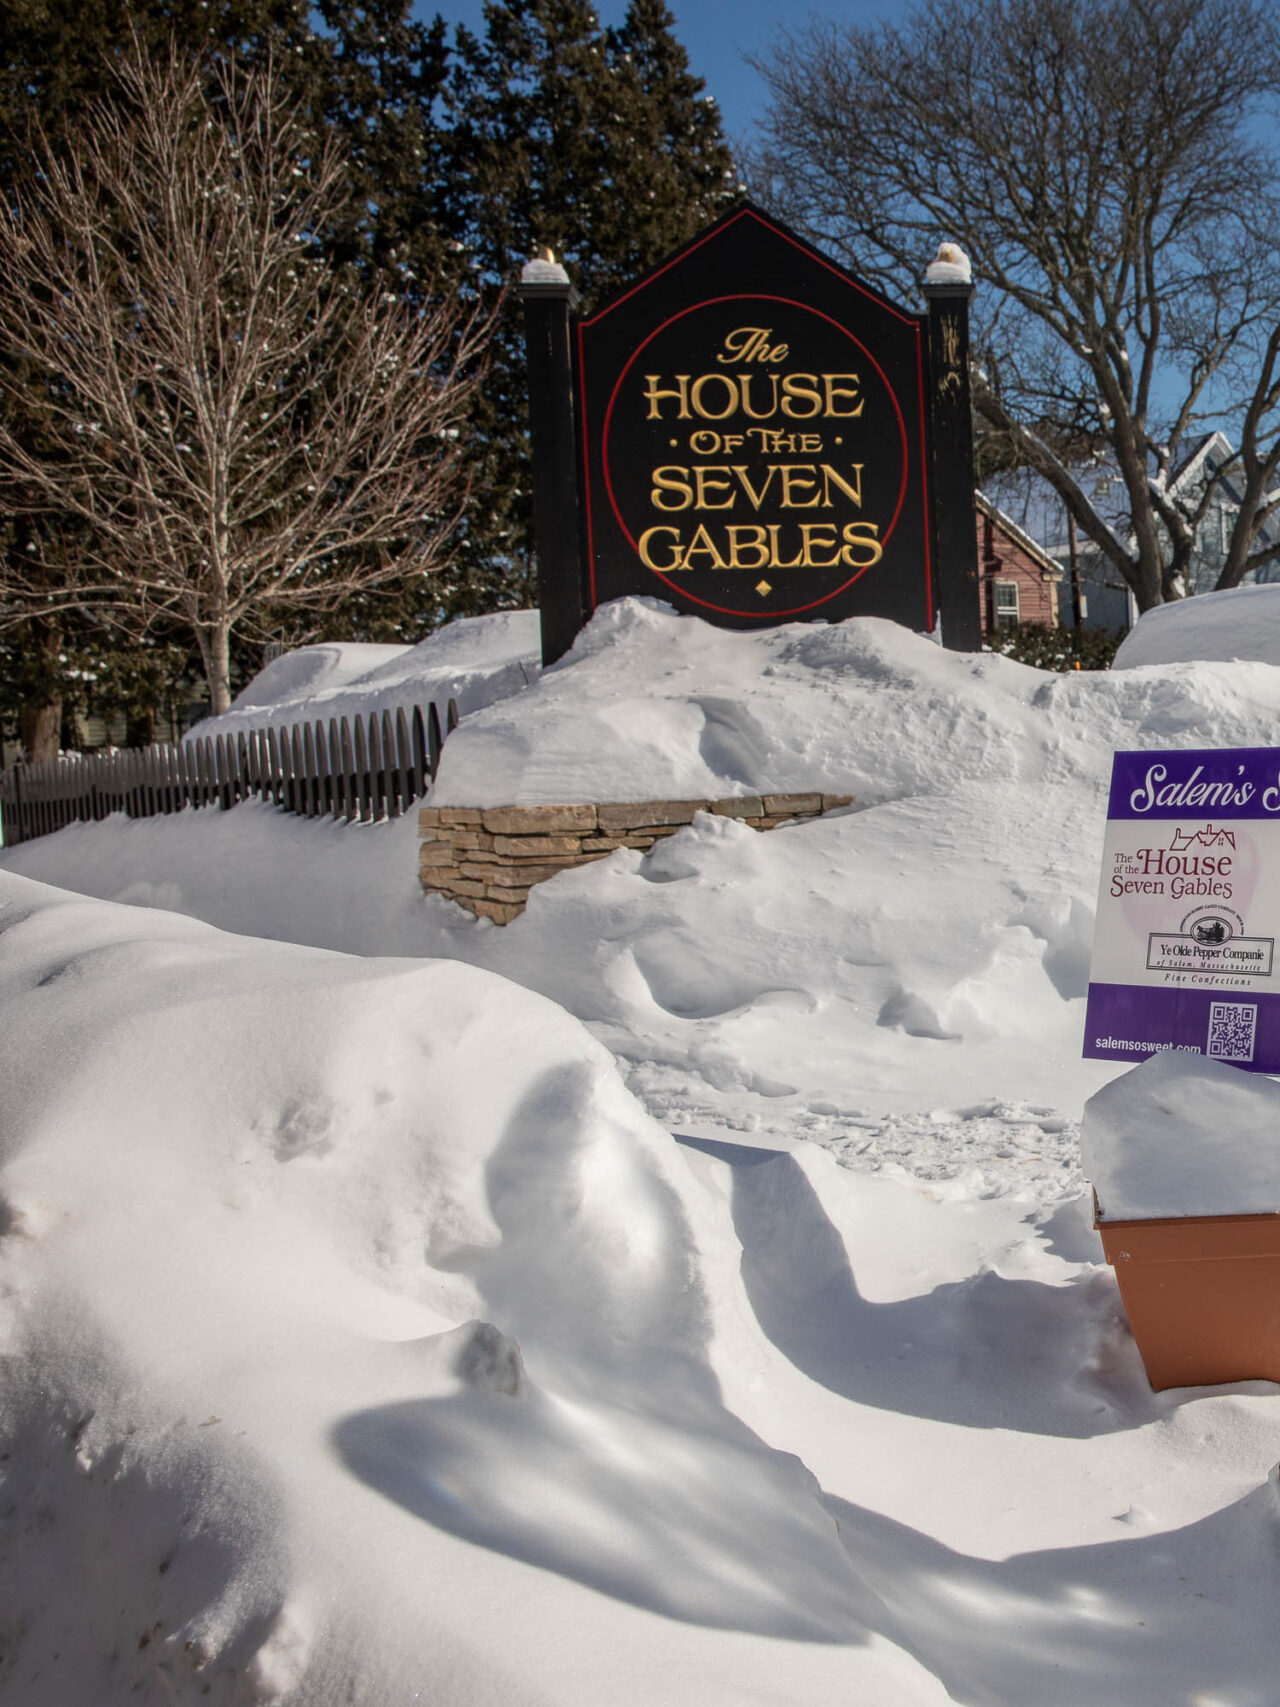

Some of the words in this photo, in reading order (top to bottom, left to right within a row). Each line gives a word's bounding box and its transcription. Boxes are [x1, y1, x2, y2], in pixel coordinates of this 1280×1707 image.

[716, 327, 790, 364] The
[643, 373, 865, 420] HOUSE
[689, 430, 745, 455] OF
[746, 427, 824, 454] THE
[650, 463, 865, 512] SEVEN
[638, 521, 883, 572] GABLES
[1129, 764, 1256, 812] Salem's
[1114, 853, 1133, 863] The
[1136, 848, 1232, 876] House
[1114, 865, 1123, 874] of
[1125, 864, 1139, 874] the
[1110, 875, 1164, 898] Seven
[1170, 876, 1233, 899] Gables
[1156, 959, 1165, 967] of
[1160, 944, 1172, 956] Ye
[1172, 944, 1192, 957] Olde
[1193, 946, 1221, 960] Pepper
[1222, 947, 1264, 962] Companie
[1164, 973, 1186, 982] Fine
[1191, 974, 1251, 986] Confections
[1095, 1036, 1201, 1054] salemsosweetcom
